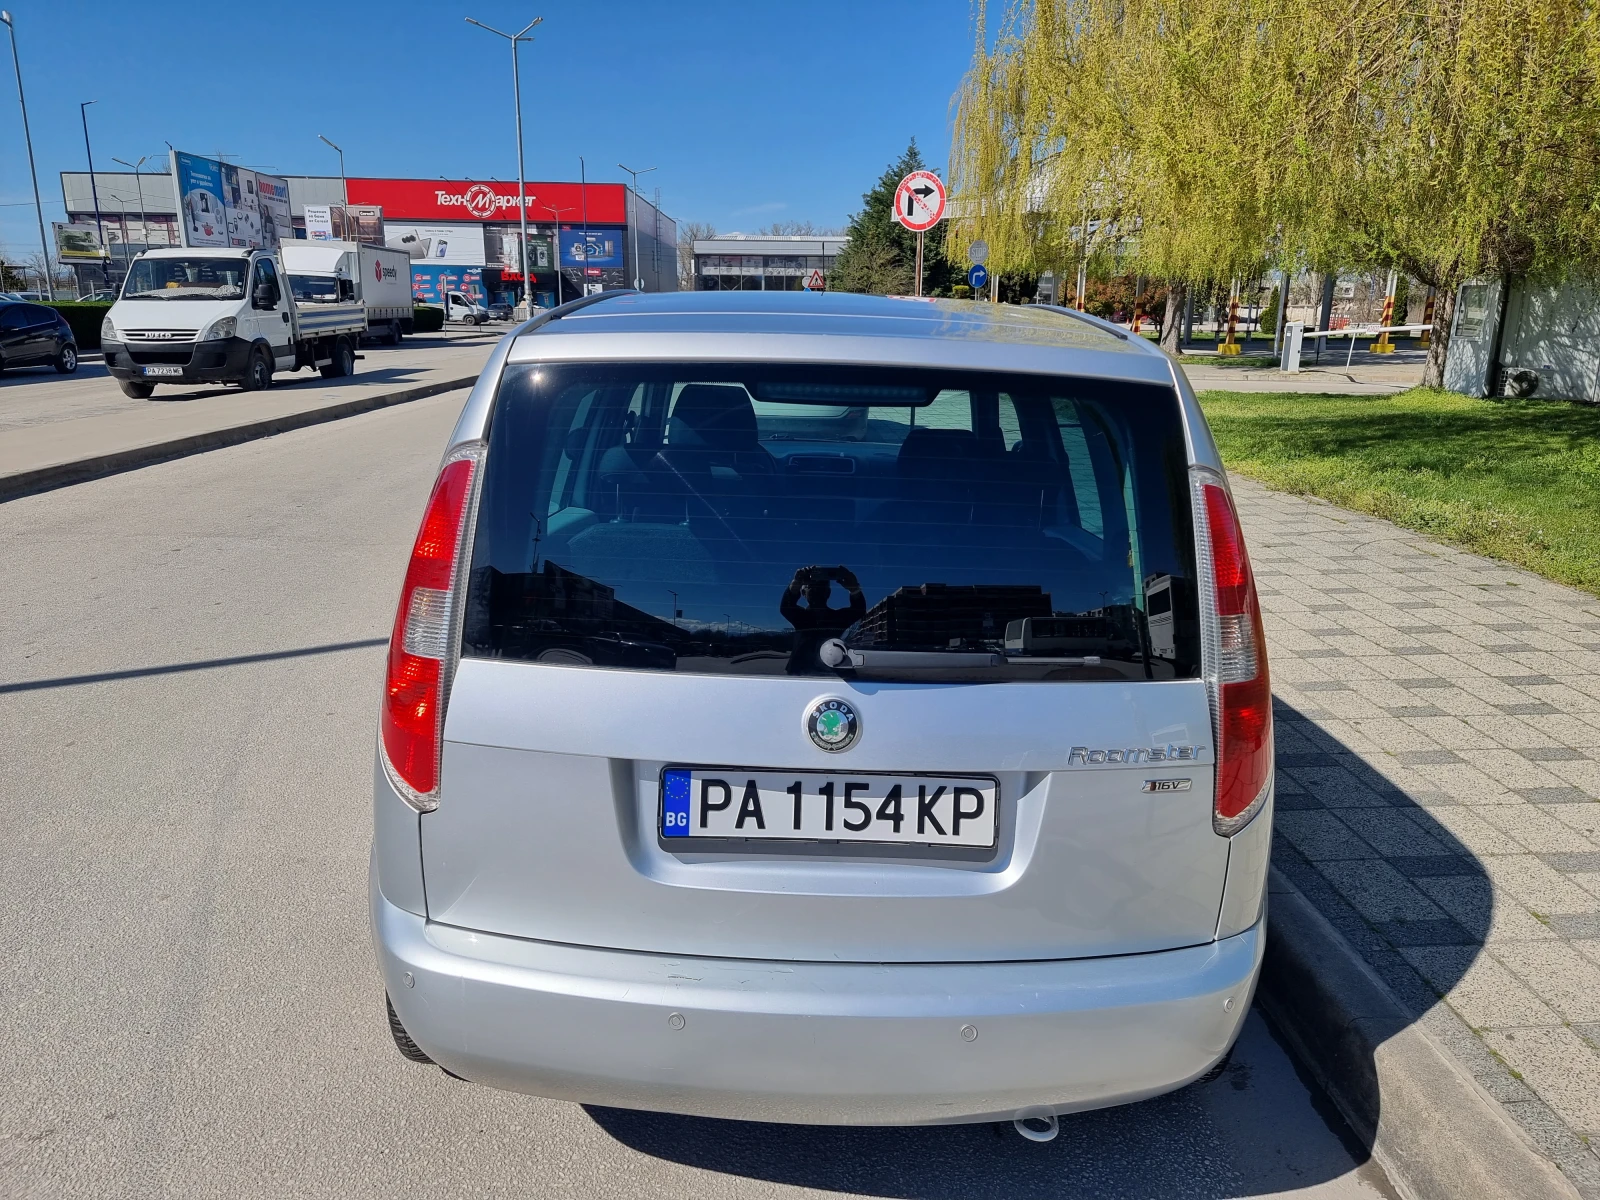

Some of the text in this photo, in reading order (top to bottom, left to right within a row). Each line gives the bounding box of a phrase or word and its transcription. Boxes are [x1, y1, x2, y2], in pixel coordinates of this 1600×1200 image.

[971, 247, 987, 257] STOP
[382, 265, 397, 281] speedy
[1067, 743, 1206, 766] Roomster
[699, 779, 984, 836] PA 1154 KP
[665, 811, 687, 827] BG
